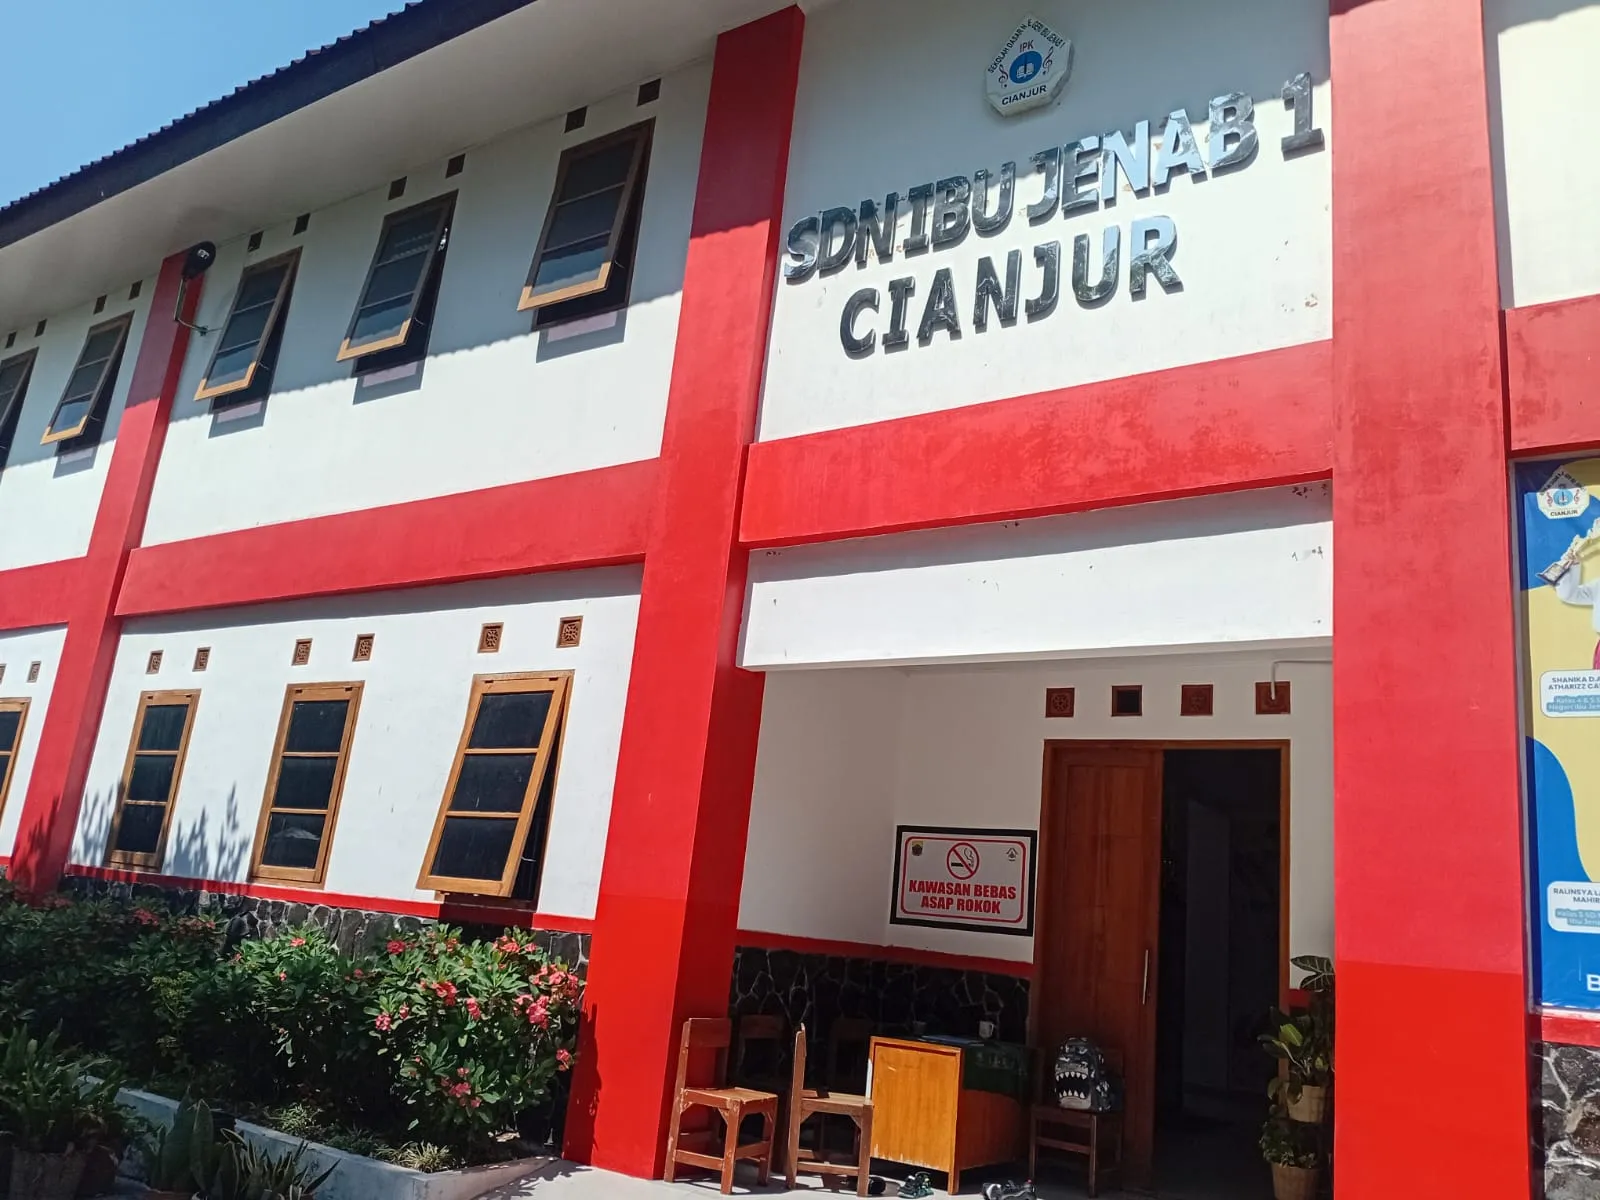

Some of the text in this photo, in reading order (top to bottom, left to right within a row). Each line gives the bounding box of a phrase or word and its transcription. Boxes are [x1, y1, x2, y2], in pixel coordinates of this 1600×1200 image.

[988, 48, 1010, 73] SEKOLAH
[1008, 28, 1024, 49] DASAR
[1019, 39, 1035, 52] IPK
[1001, 84, 1047, 106] CIANJUR
[784, 71, 1325, 280] SDN IBU JENAB 1
[840, 215, 1184, 360] CIANJUR
[908, 880, 1017, 900] KAWASAN BEBAS
[920, 896, 1001, 914] ASAP ROKOK
